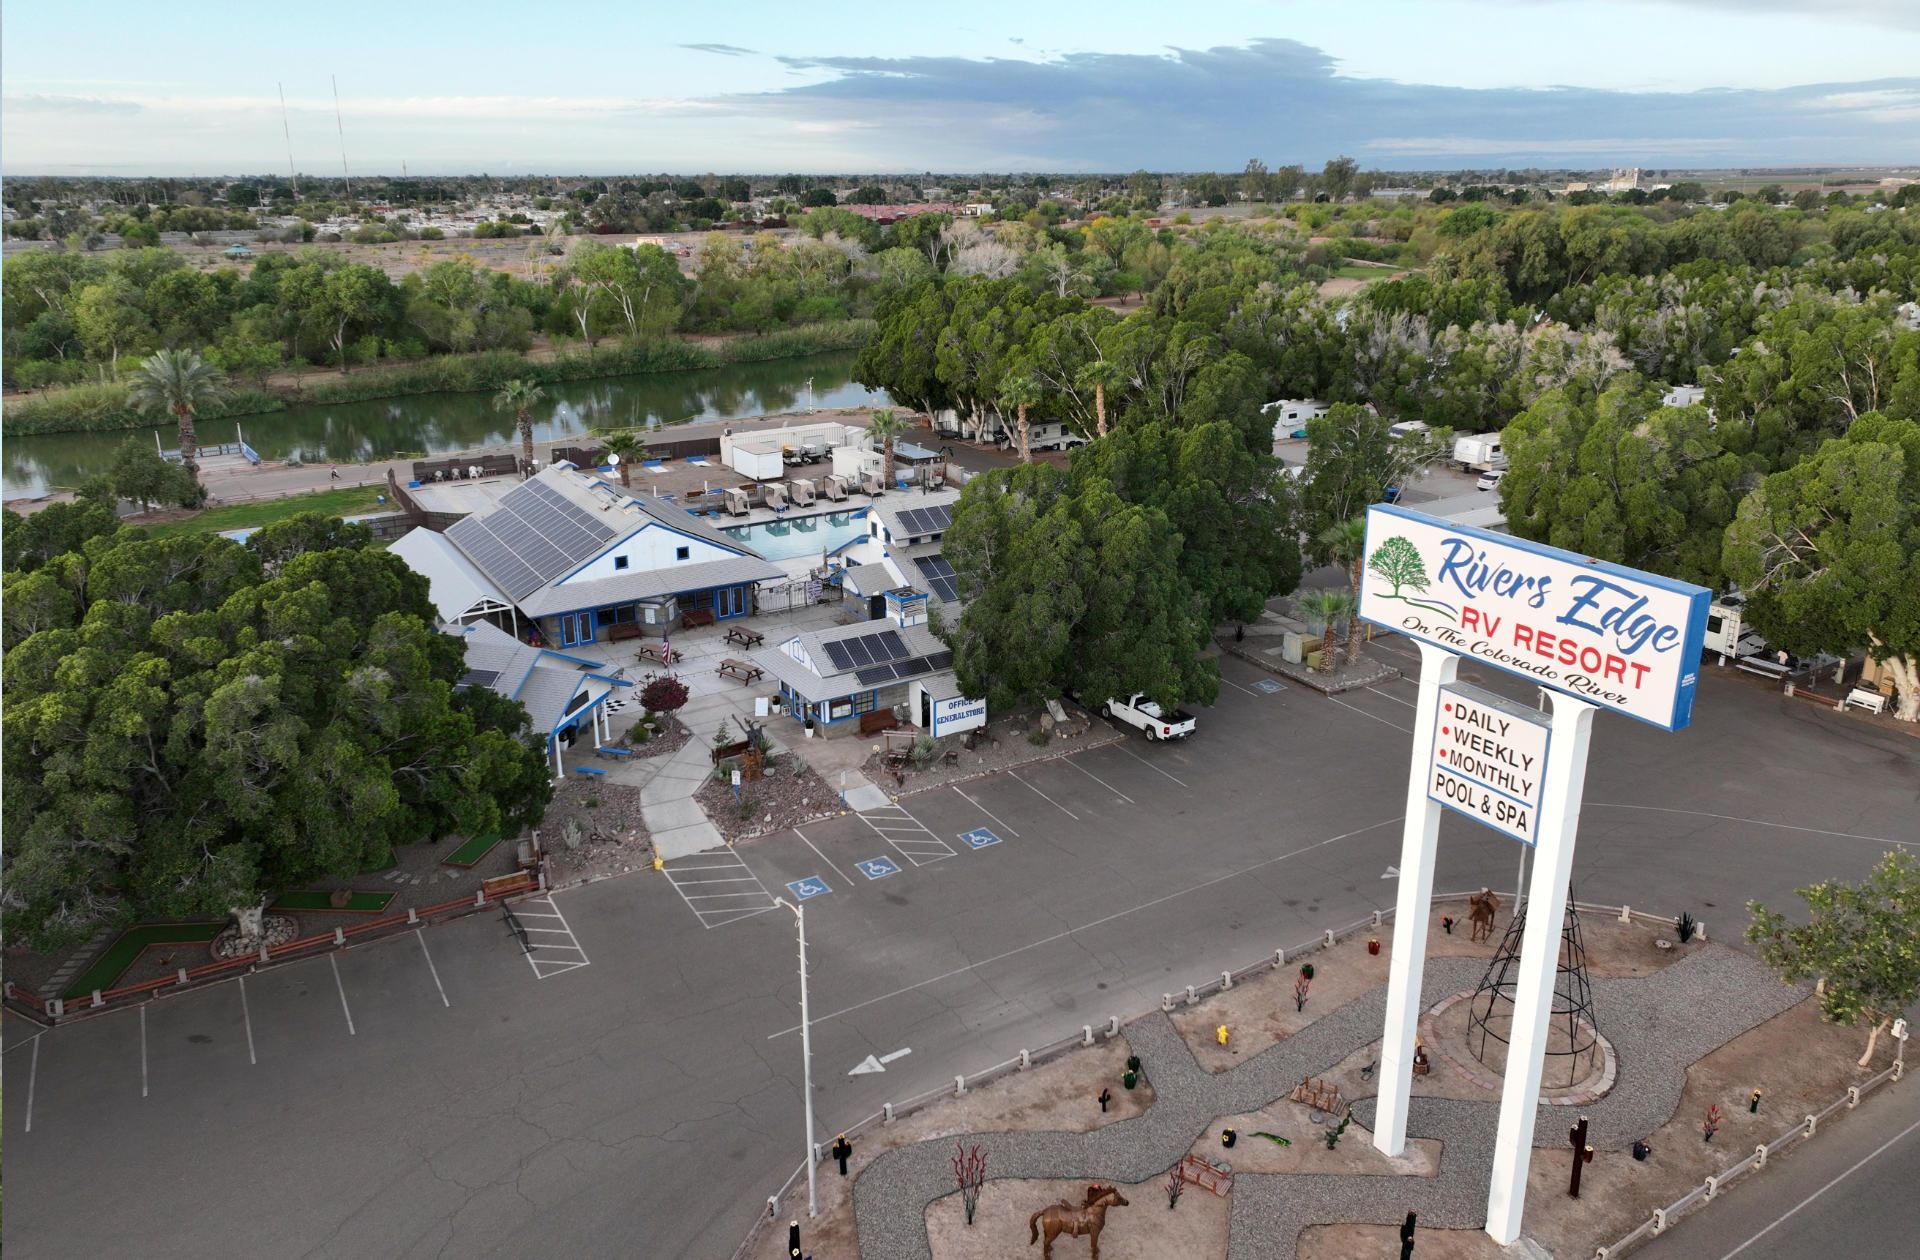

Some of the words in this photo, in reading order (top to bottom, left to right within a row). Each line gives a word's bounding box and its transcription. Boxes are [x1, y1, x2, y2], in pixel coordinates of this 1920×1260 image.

[1438, 538, 1552, 609] Rivers
[1556, 574, 1680, 655] Edge
[1402, 616, 1431, 635] On
[1434, 626, 1467, 648] The
[1469, 640, 1558, 680] Colorado
[1564, 673, 1628, 705] River
[1461, 606, 1501, 638] RV
[1513, 623, 1651, 690] RESORT
[936, 712, 966, 725] GENERAL
[966, 706, 985, 718] STORE
[949, 699, 973, 710] OFFICE
[1455, 703, 1510, 737] DAILY
[1449, 749, 1532, 797] MONTHLY
[1453, 726, 1534, 772] WEEKLY
[1435, 773, 1476, 809] POOL
[1481, 795, 1491, 815] &
[1495, 800, 1528, 832] SPA
